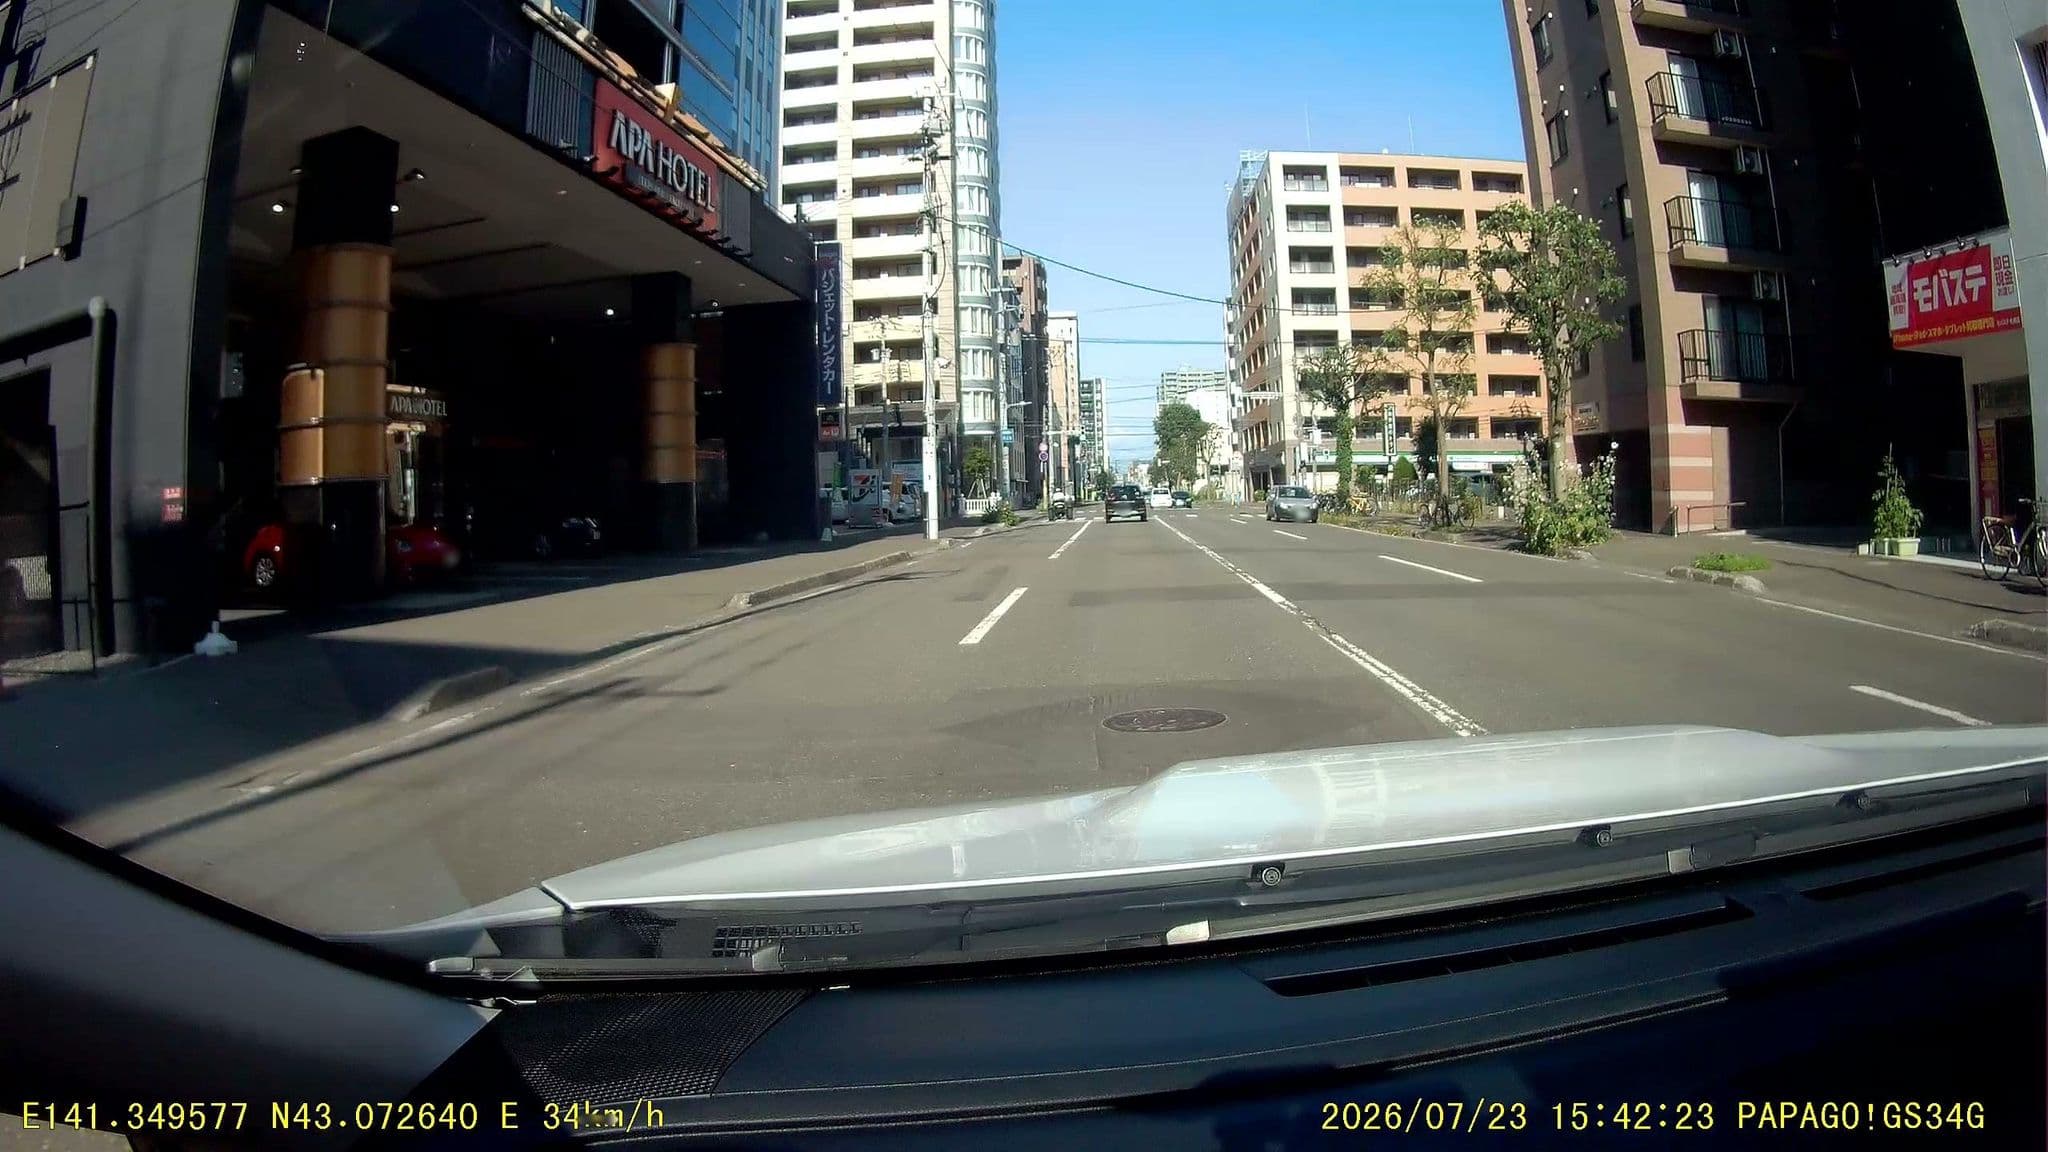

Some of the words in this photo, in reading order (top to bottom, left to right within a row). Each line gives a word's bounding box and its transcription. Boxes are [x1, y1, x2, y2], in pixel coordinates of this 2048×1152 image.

[610, 110, 655, 173] APA
[656, 138, 716, 213] HOTEL
[1913, 265, 1986, 312] モバステ
[392, 396, 412, 414] APA
[413, 399, 447, 416] HOTEL
